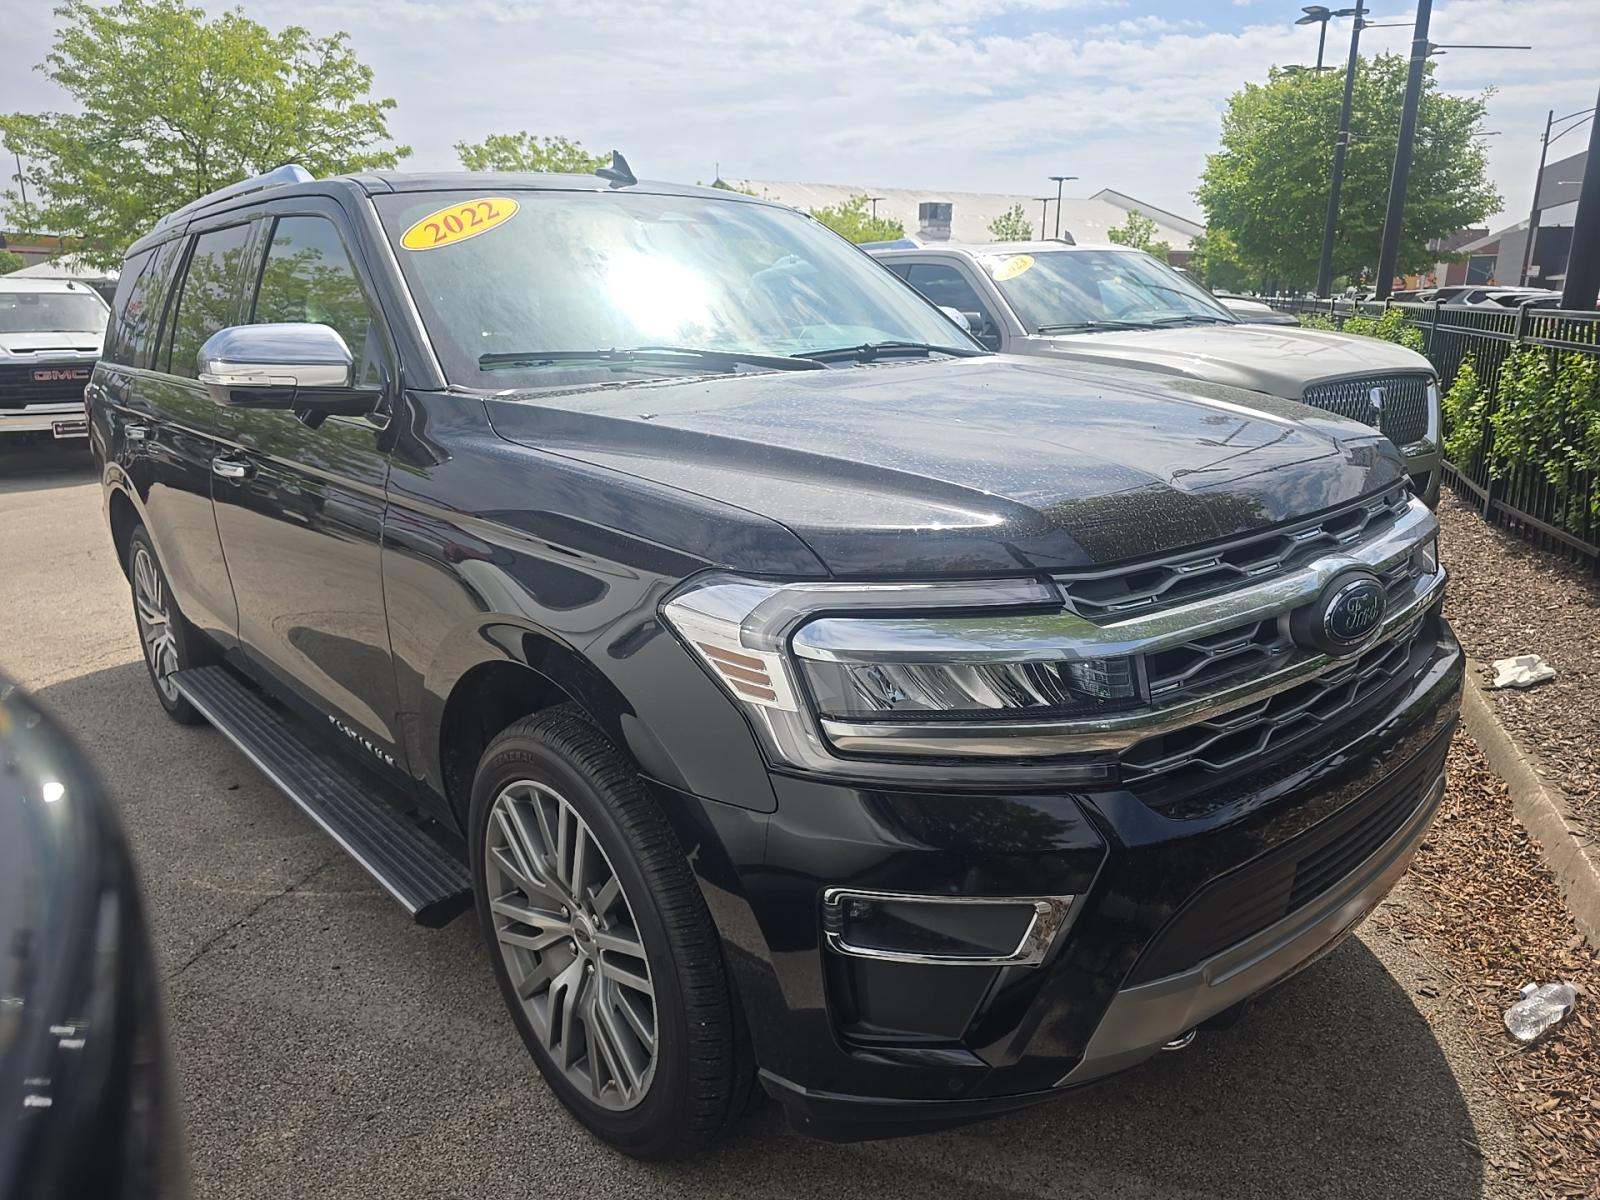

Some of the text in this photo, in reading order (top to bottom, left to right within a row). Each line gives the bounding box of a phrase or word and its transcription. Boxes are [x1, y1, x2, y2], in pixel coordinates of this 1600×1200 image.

[424, 202, 500, 243] 2022
[33, 370, 90, 381] GMC
[1345, 593, 1379, 630] Ford
